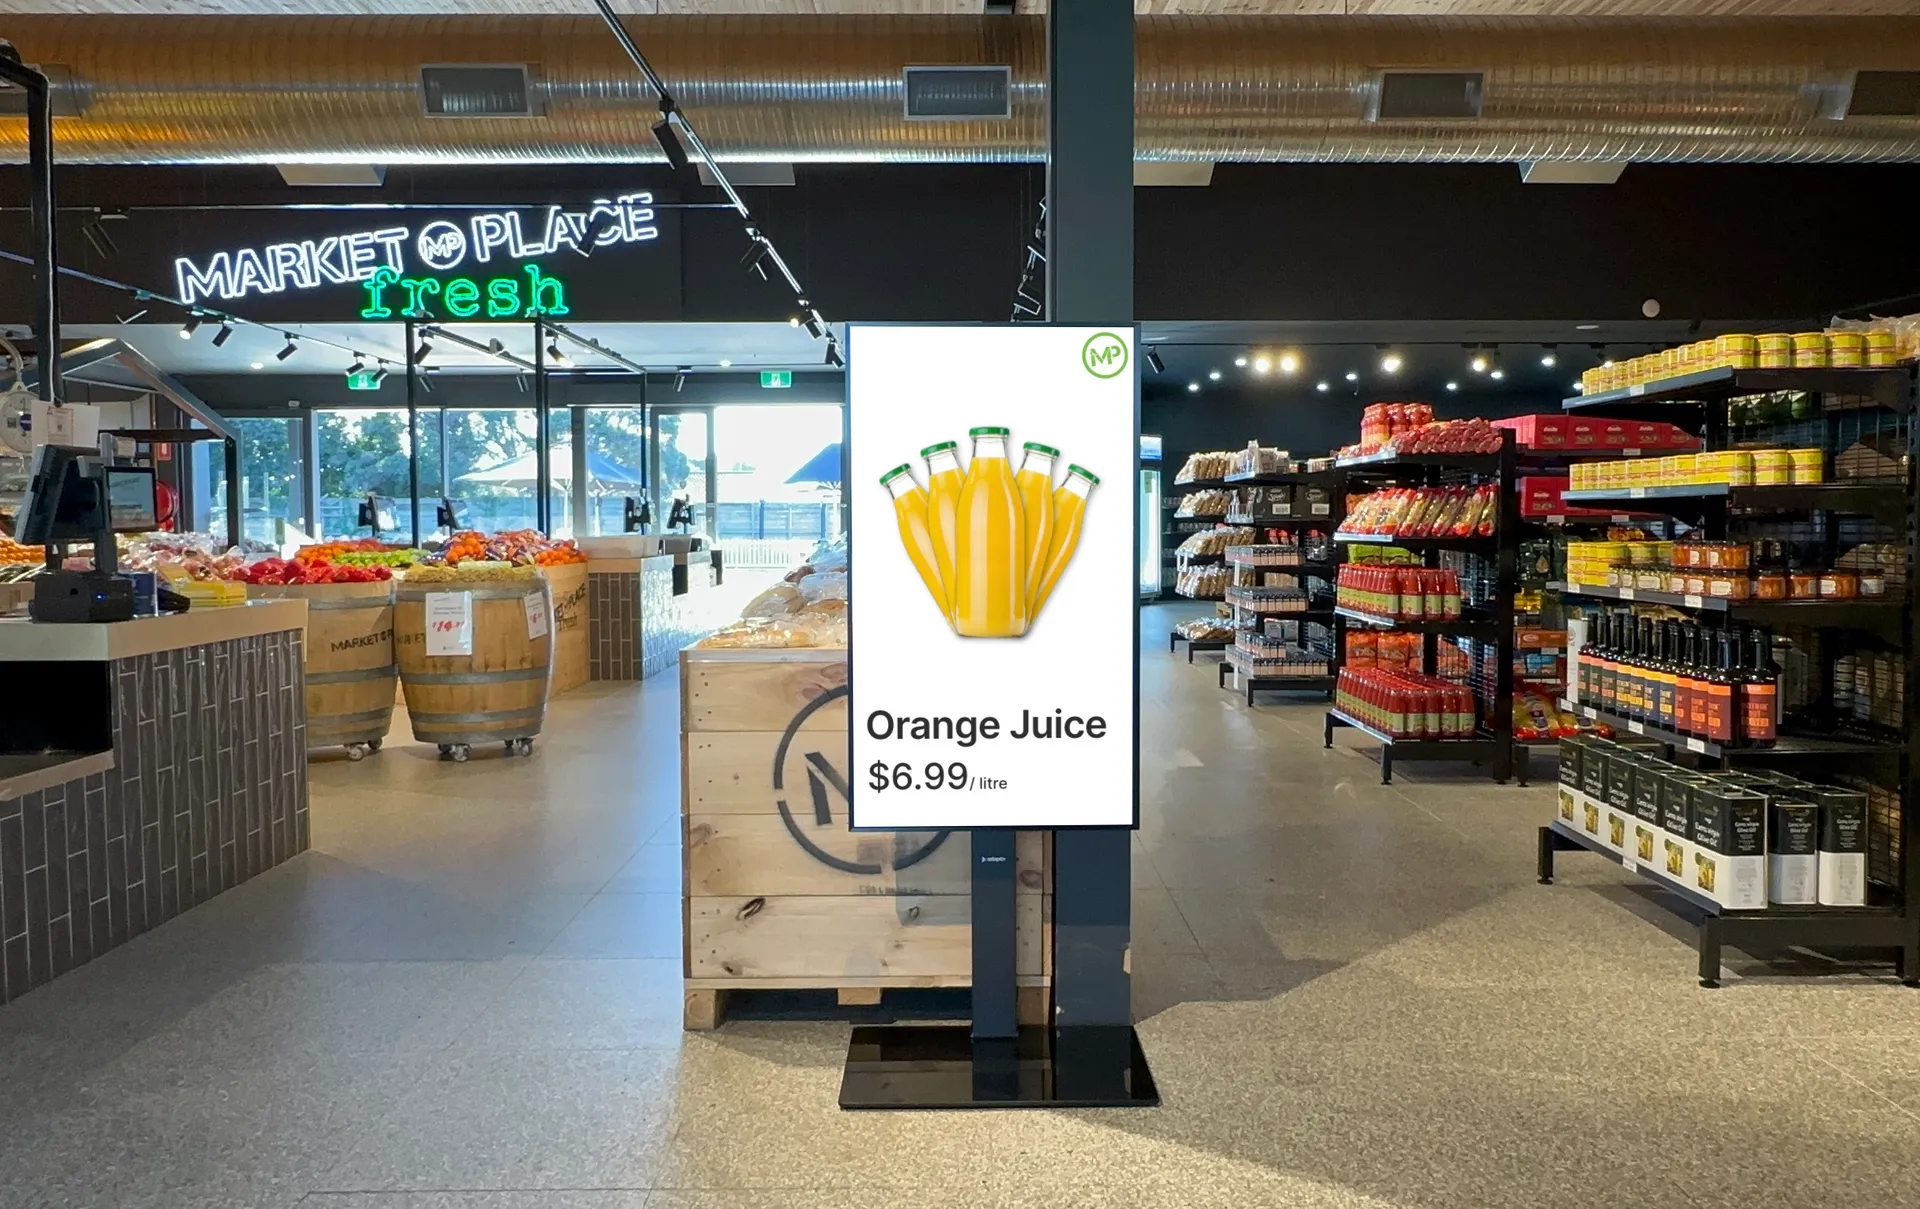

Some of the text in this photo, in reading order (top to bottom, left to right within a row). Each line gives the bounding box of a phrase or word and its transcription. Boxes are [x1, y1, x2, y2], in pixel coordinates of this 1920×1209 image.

[175, 227, 409, 304] MARKET
[472, 192, 658, 263] PLACE
[361, 264, 570, 318] fresh
[866, 707, 1107, 748] Orange Juice
[868, 760, 968, 794] $6.99
[979, 777, 1008, 790] litre
